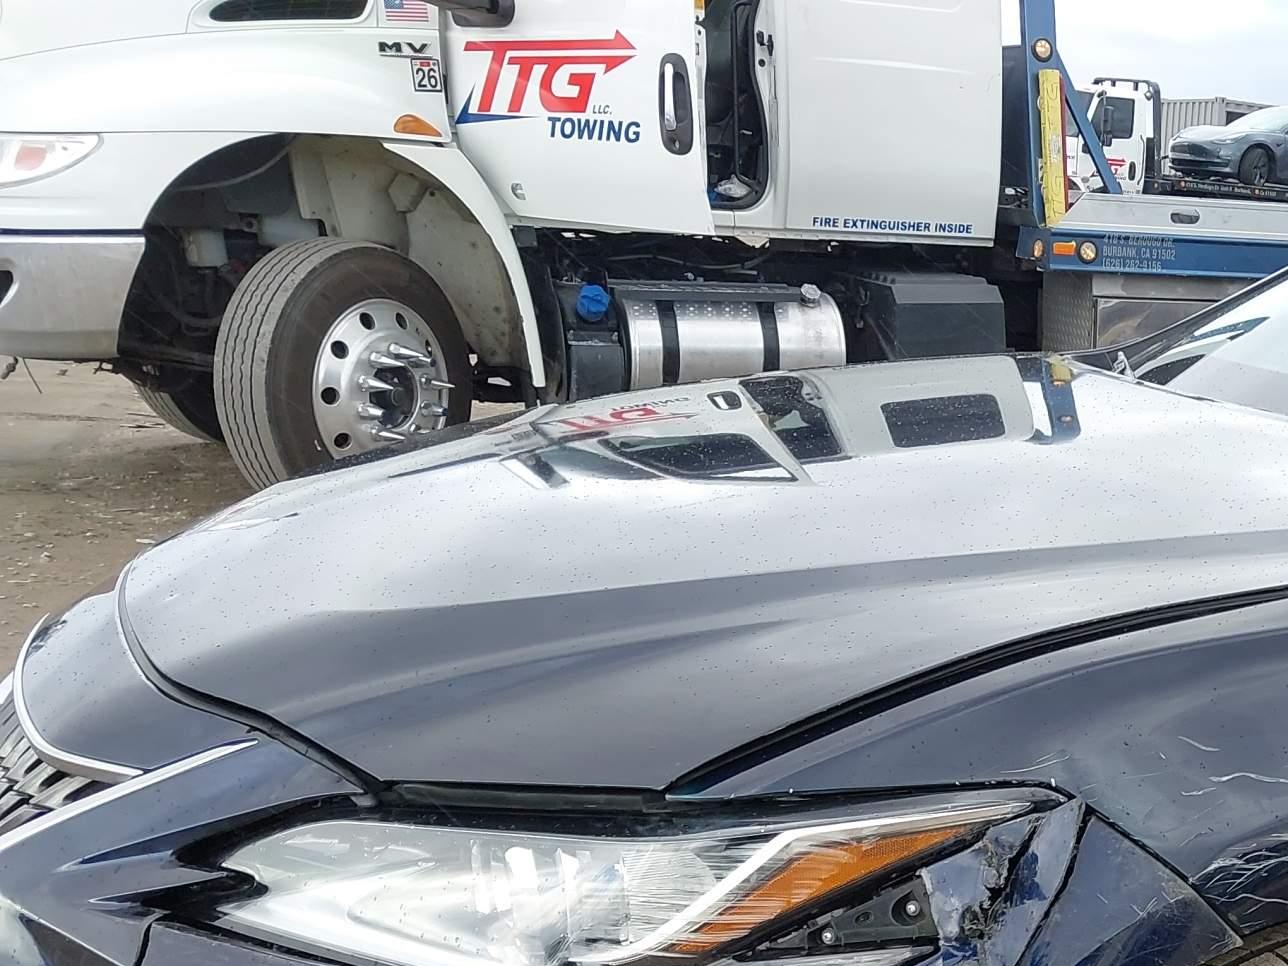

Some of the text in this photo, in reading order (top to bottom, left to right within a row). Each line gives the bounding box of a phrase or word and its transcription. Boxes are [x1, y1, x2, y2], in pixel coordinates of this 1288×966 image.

[378, 41, 430, 53] MV
[416, 68, 438, 88] 26
[464, 34, 622, 113] TTG
[593, 105, 613, 115] LLC.
[547, 116, 641, 143] TOWING
[812, 216, 973, 234] FIRE EXTINGUISHER INSIDE
[1102, 246, 1176, 261] BURBANK, CA 91502
[1102, 258, 1124, 270] (626)
